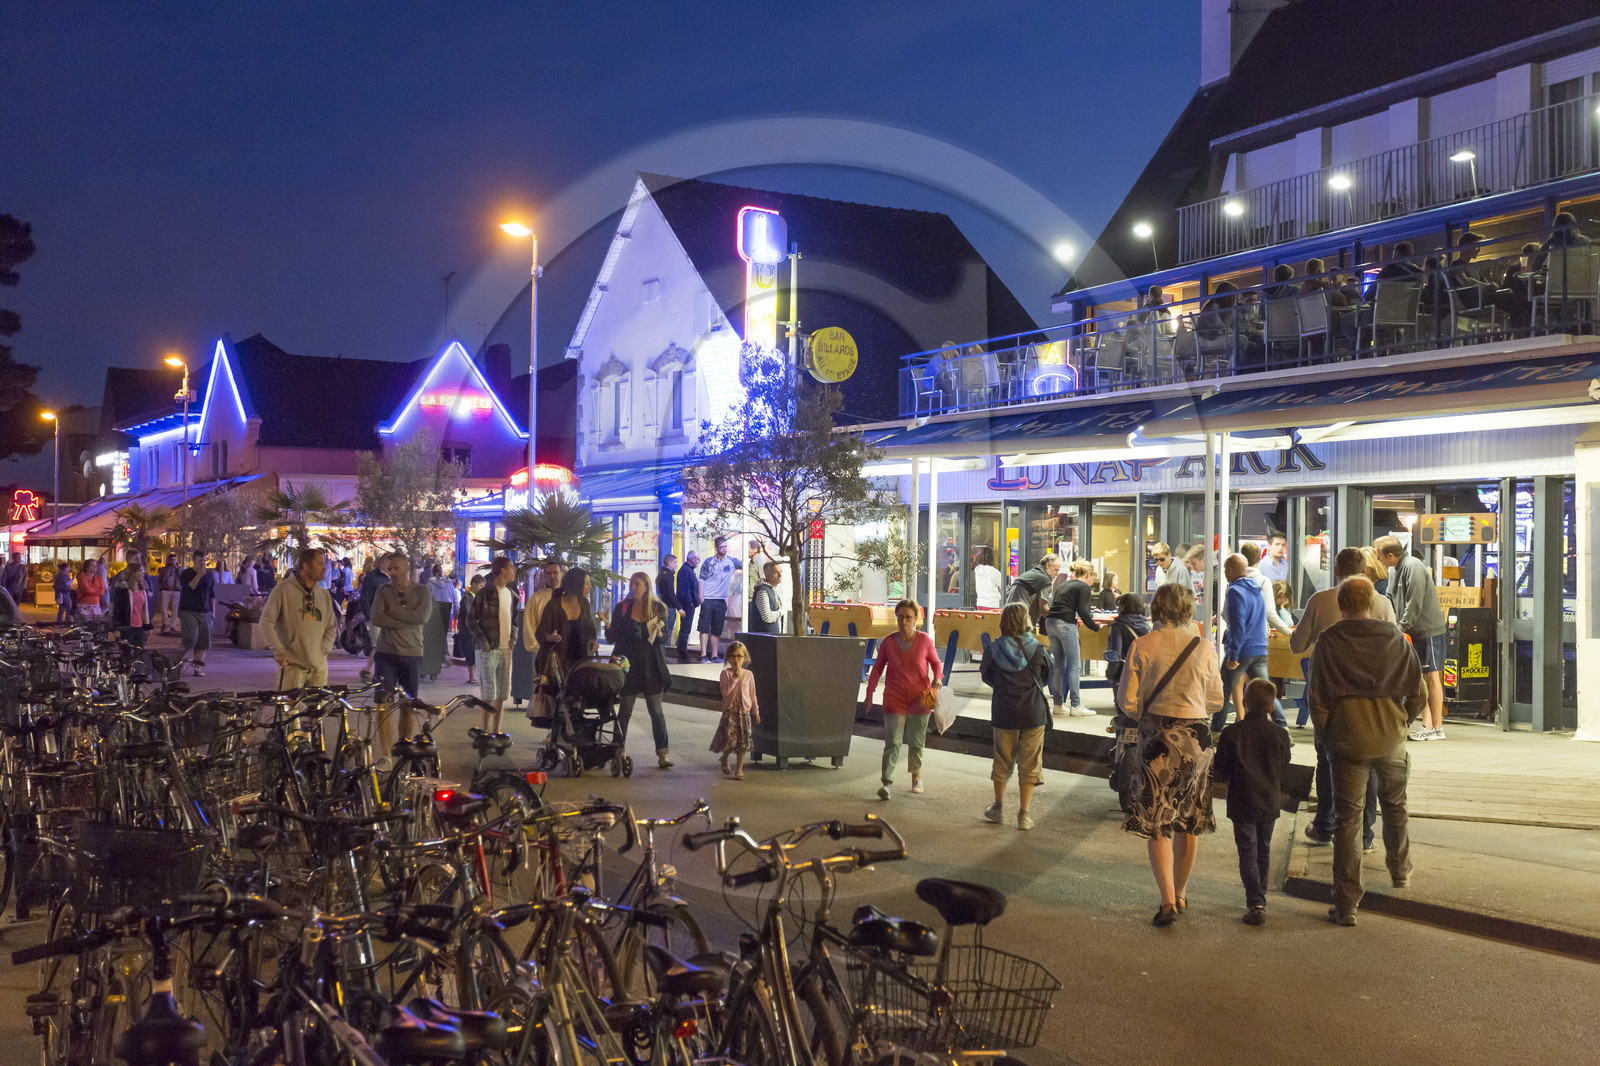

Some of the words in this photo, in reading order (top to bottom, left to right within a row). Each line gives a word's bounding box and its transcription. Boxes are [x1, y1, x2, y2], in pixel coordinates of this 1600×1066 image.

[830, 331, 845, 341] BAR
[818, 342, 854, 356] BILLARDS
[1462, 667, 1488, 675] SHOCKER
